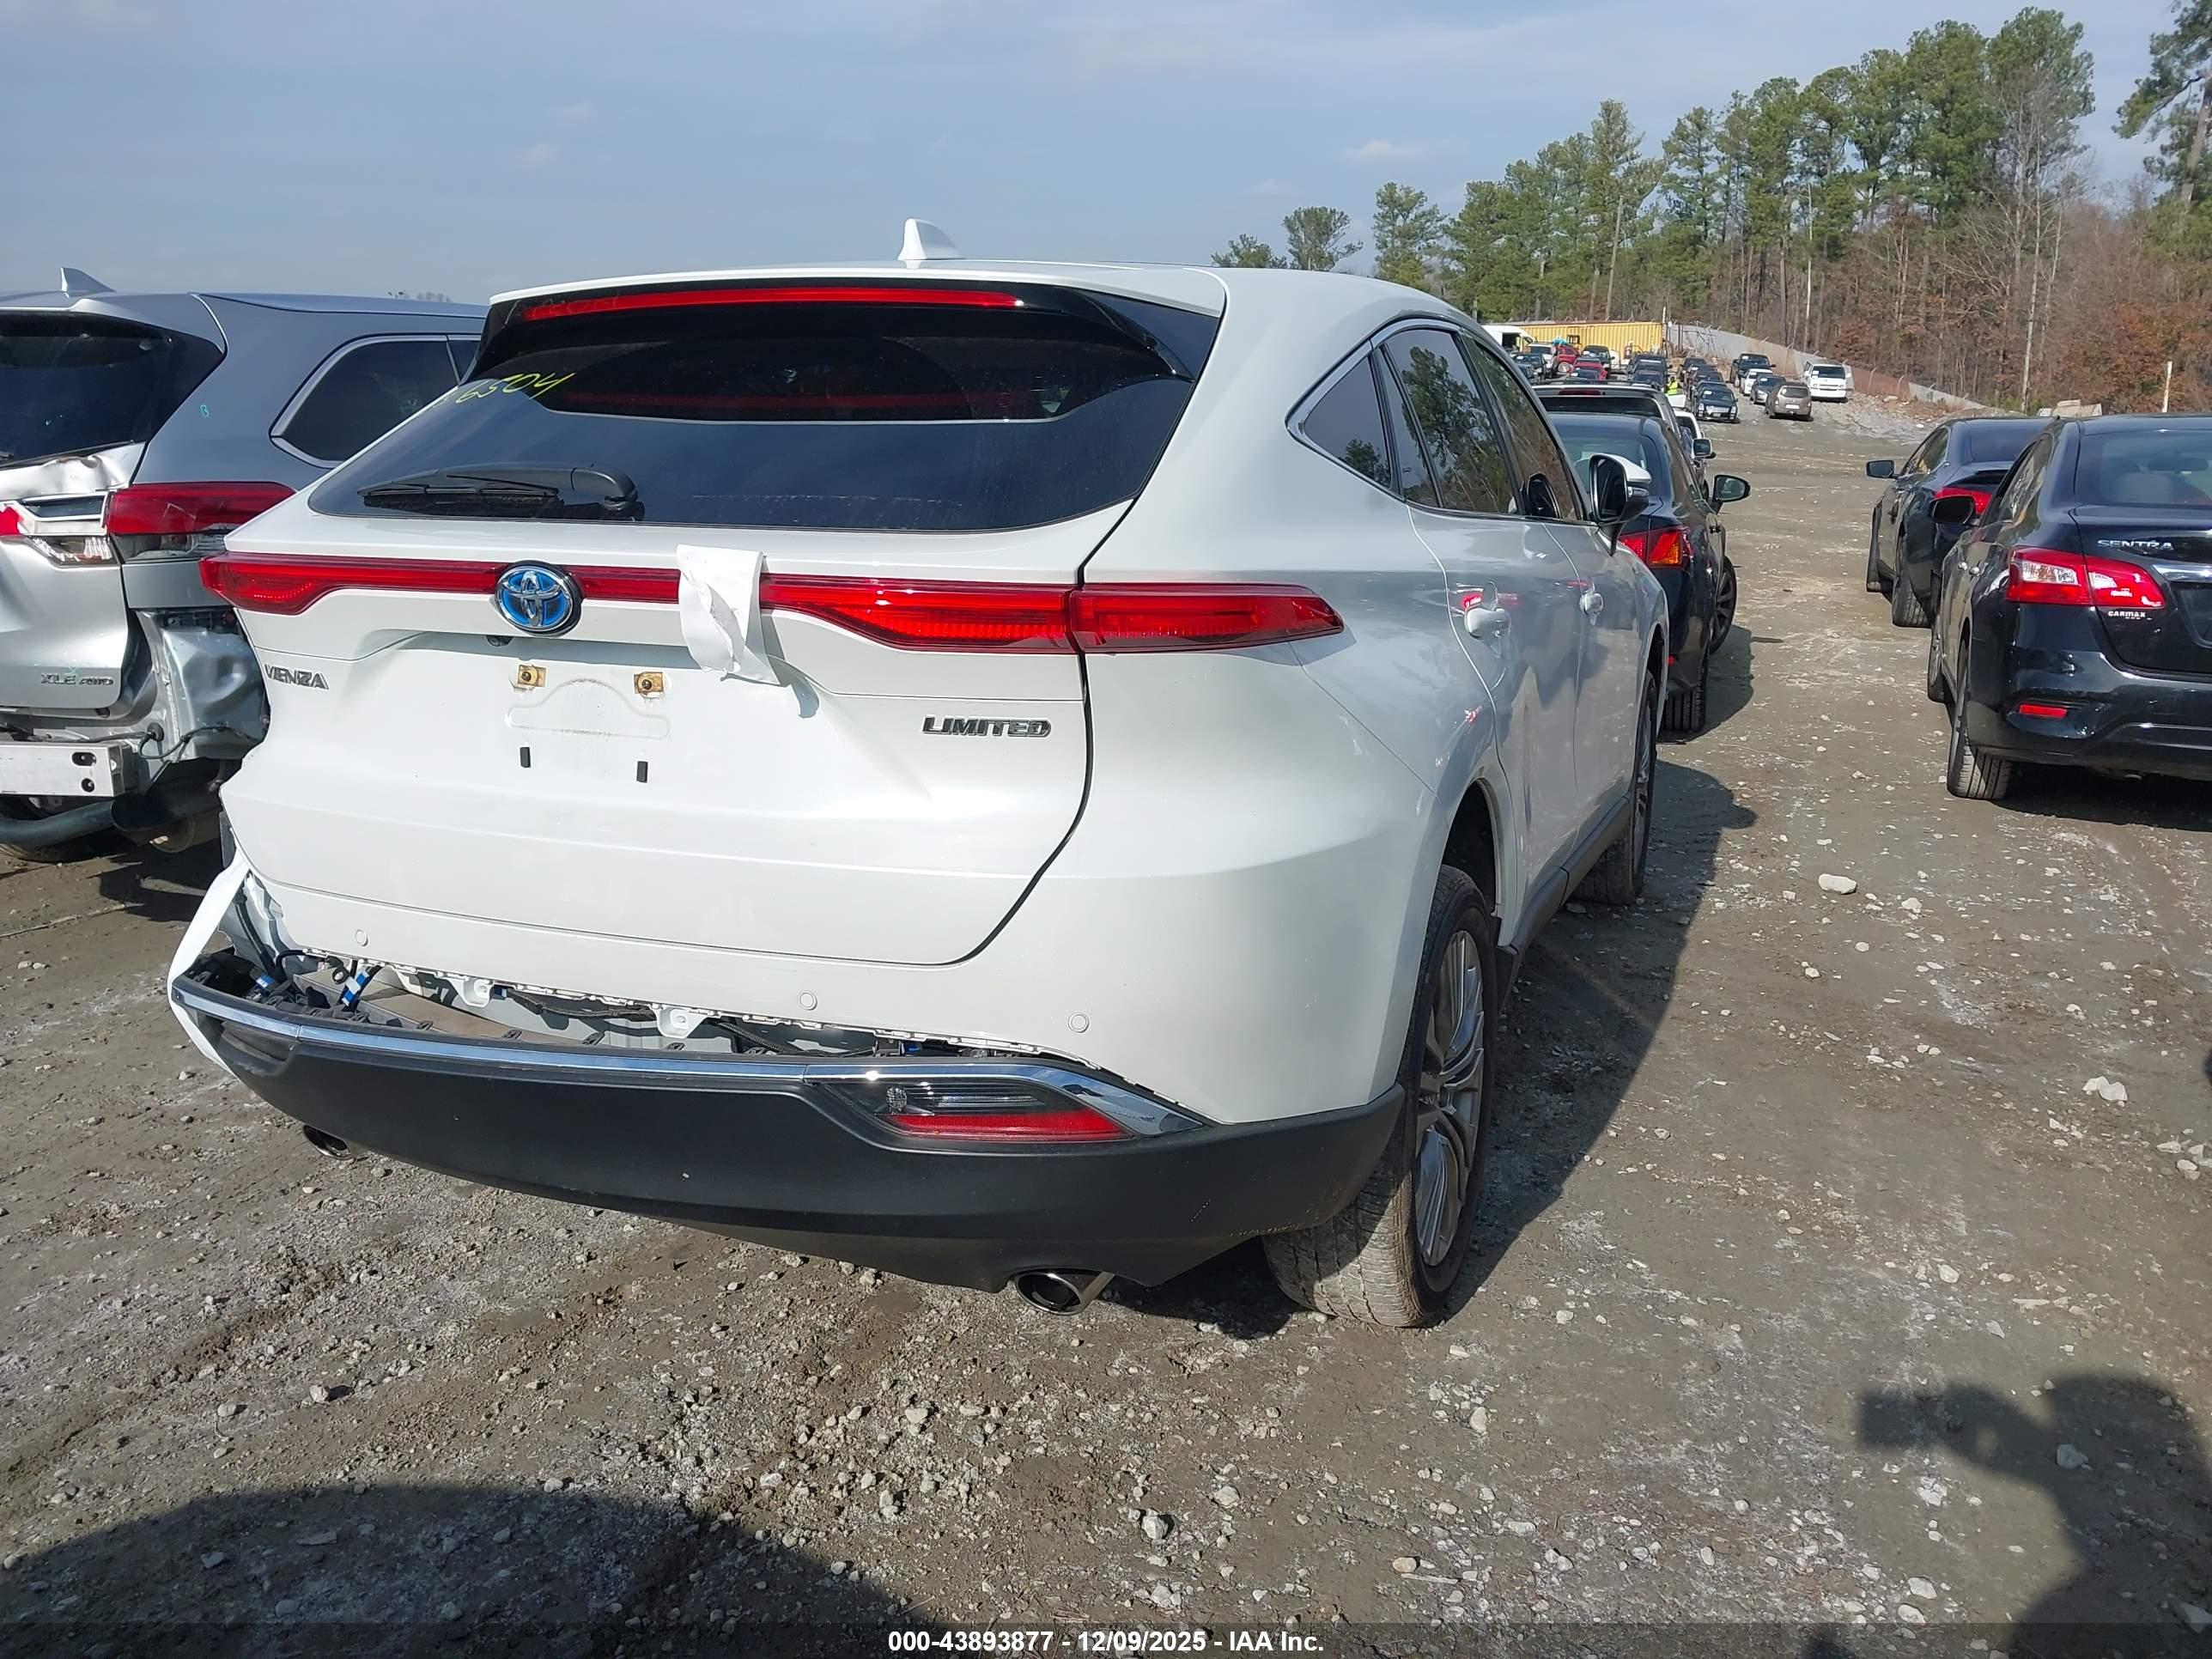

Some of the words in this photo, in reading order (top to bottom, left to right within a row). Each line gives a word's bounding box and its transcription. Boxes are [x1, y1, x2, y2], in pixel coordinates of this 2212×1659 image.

[2097, 538, 2174, 550] SENTRA
[40, 672, 76, 685] XLE
[78, 677, 114, 685] AWD
[264, 663, 330, 690] VENZA
[922, 716, 1052, 738] LIMITED
